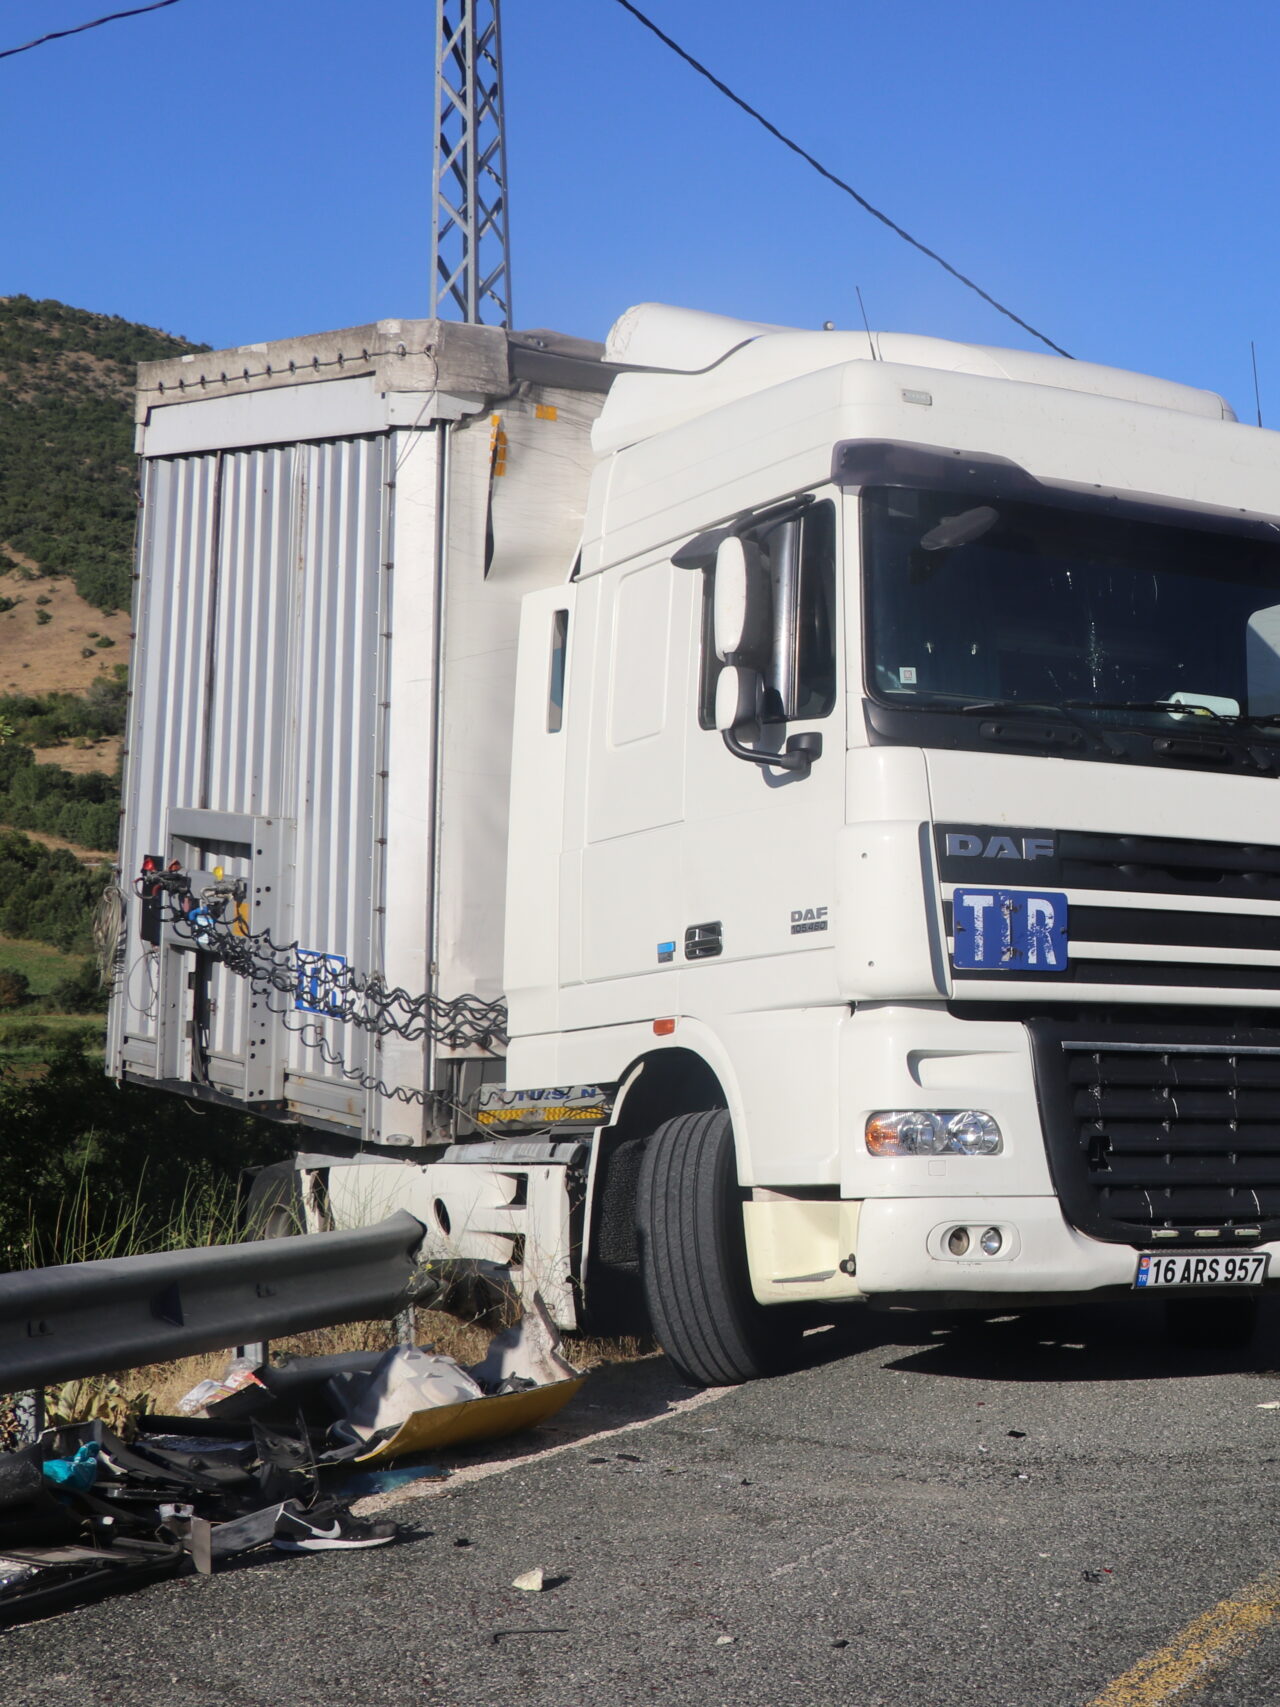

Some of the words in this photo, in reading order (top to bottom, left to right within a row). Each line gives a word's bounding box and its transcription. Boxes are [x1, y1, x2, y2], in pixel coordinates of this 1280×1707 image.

[945, 833, 1055, 860] DAF
[790, 906, 828, 923] DAF
[962, 894, 1057, 965] TIR
[1153, 1258, 1177, 1284] 16
[1180, 1258, 1220, 1283] ARS
[1223, 1257, 1264, 1282] 957
